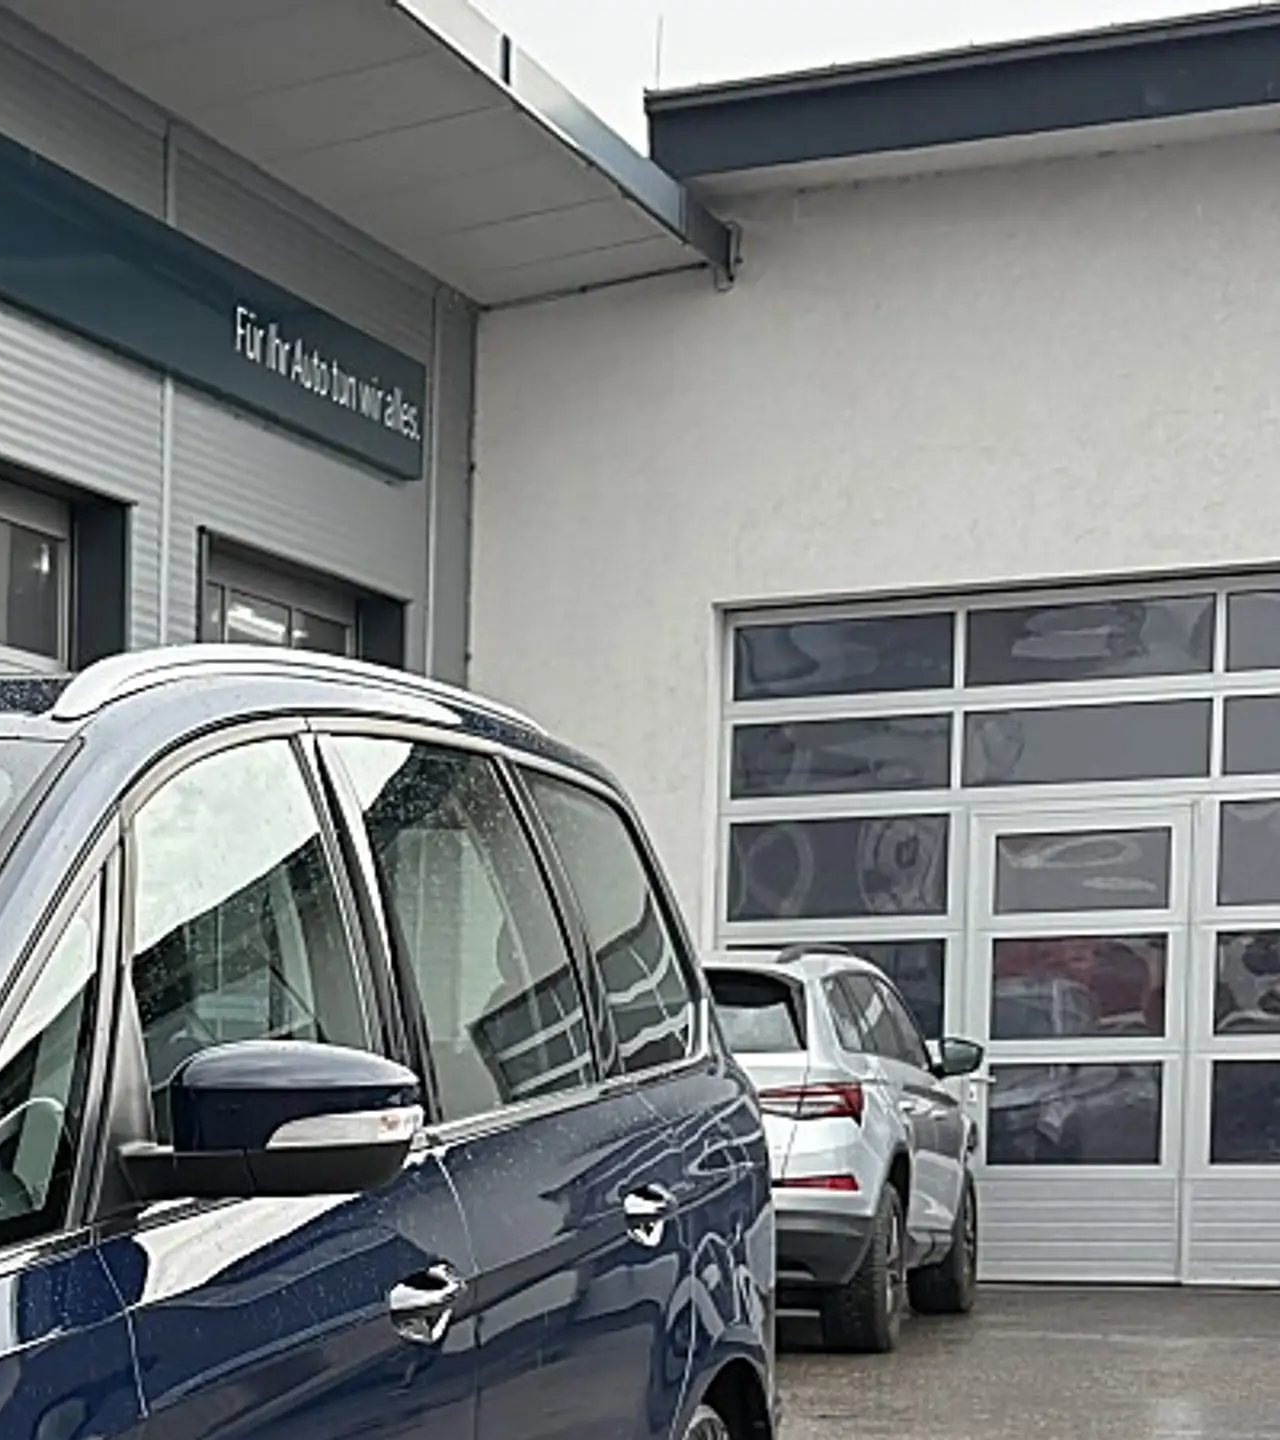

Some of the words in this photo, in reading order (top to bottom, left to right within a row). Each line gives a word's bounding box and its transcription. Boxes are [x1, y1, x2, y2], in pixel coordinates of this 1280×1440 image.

[235, 304, 265, 364] Für
[266, 322, 290, 377] Ihr
[291, 337, 331, 397] Auto
[331, 358, 357, 412] tun
[358, 375, 383, 422] wir
